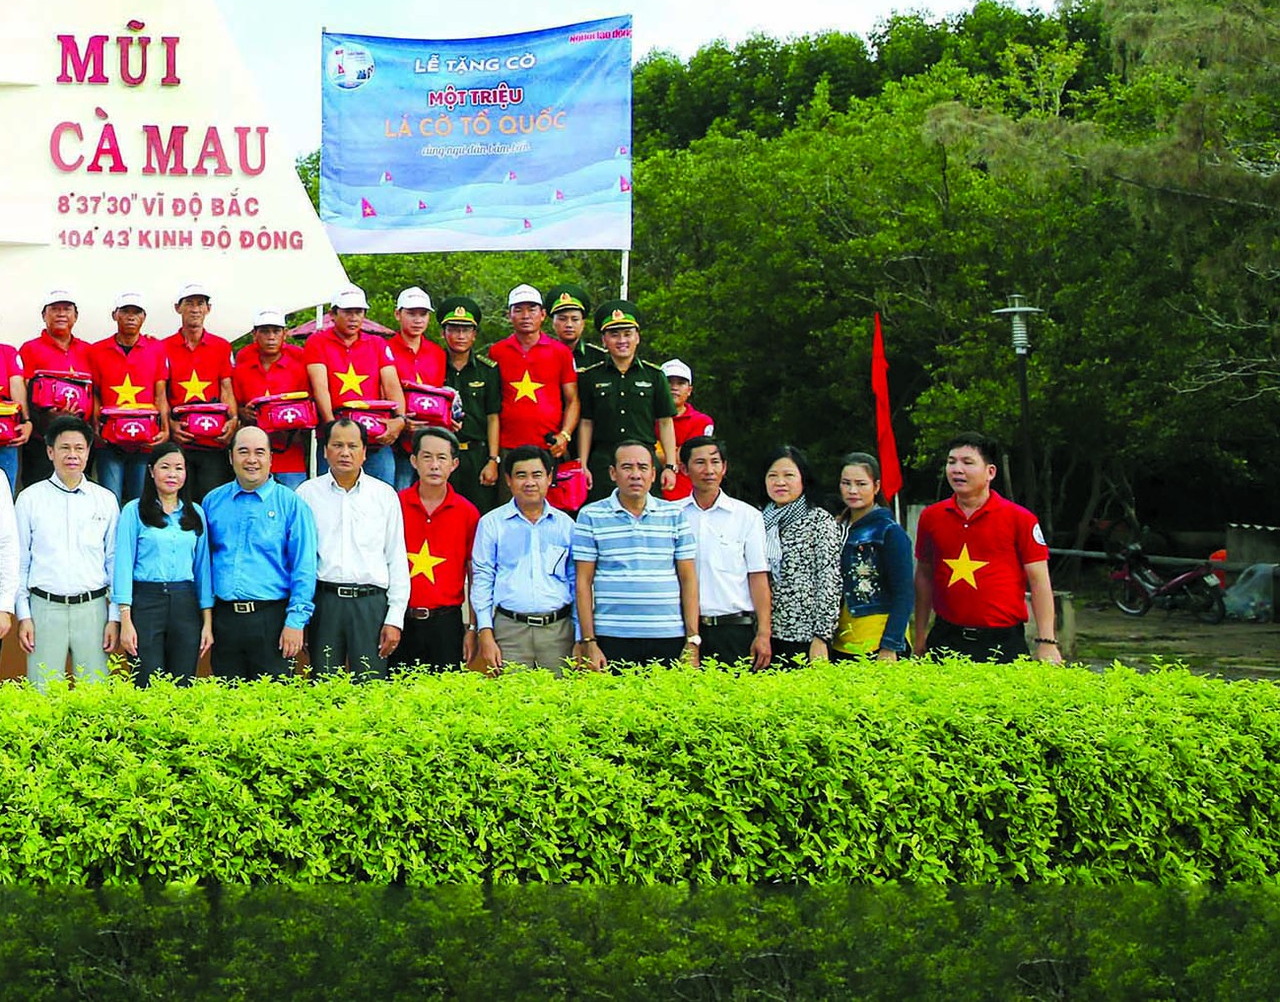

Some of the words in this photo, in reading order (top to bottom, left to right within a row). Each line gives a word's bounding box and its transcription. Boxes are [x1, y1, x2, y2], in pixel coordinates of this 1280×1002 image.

[56, 20, 181, 86] MŨI
[415, 54, 440, 73] LỄ
[446, 56, 500, 75] TẶNG
[428, 85, 467, 111] MỘT
[470, 82, 523, 108] TRIỆU
[499, 107, 567, 135] QUỐC
[50, 107, 128, 173] CÀ
[142, 125, 269, 177] MAU
[142, 192, 164, 217] VĨ
[171, 193, 203, 222] ĐỘ
[211, 188, 259, 217] BẮC
[138, 230, 194, 249] KINH
[239, 226, 304, 250] ĐÔNG
